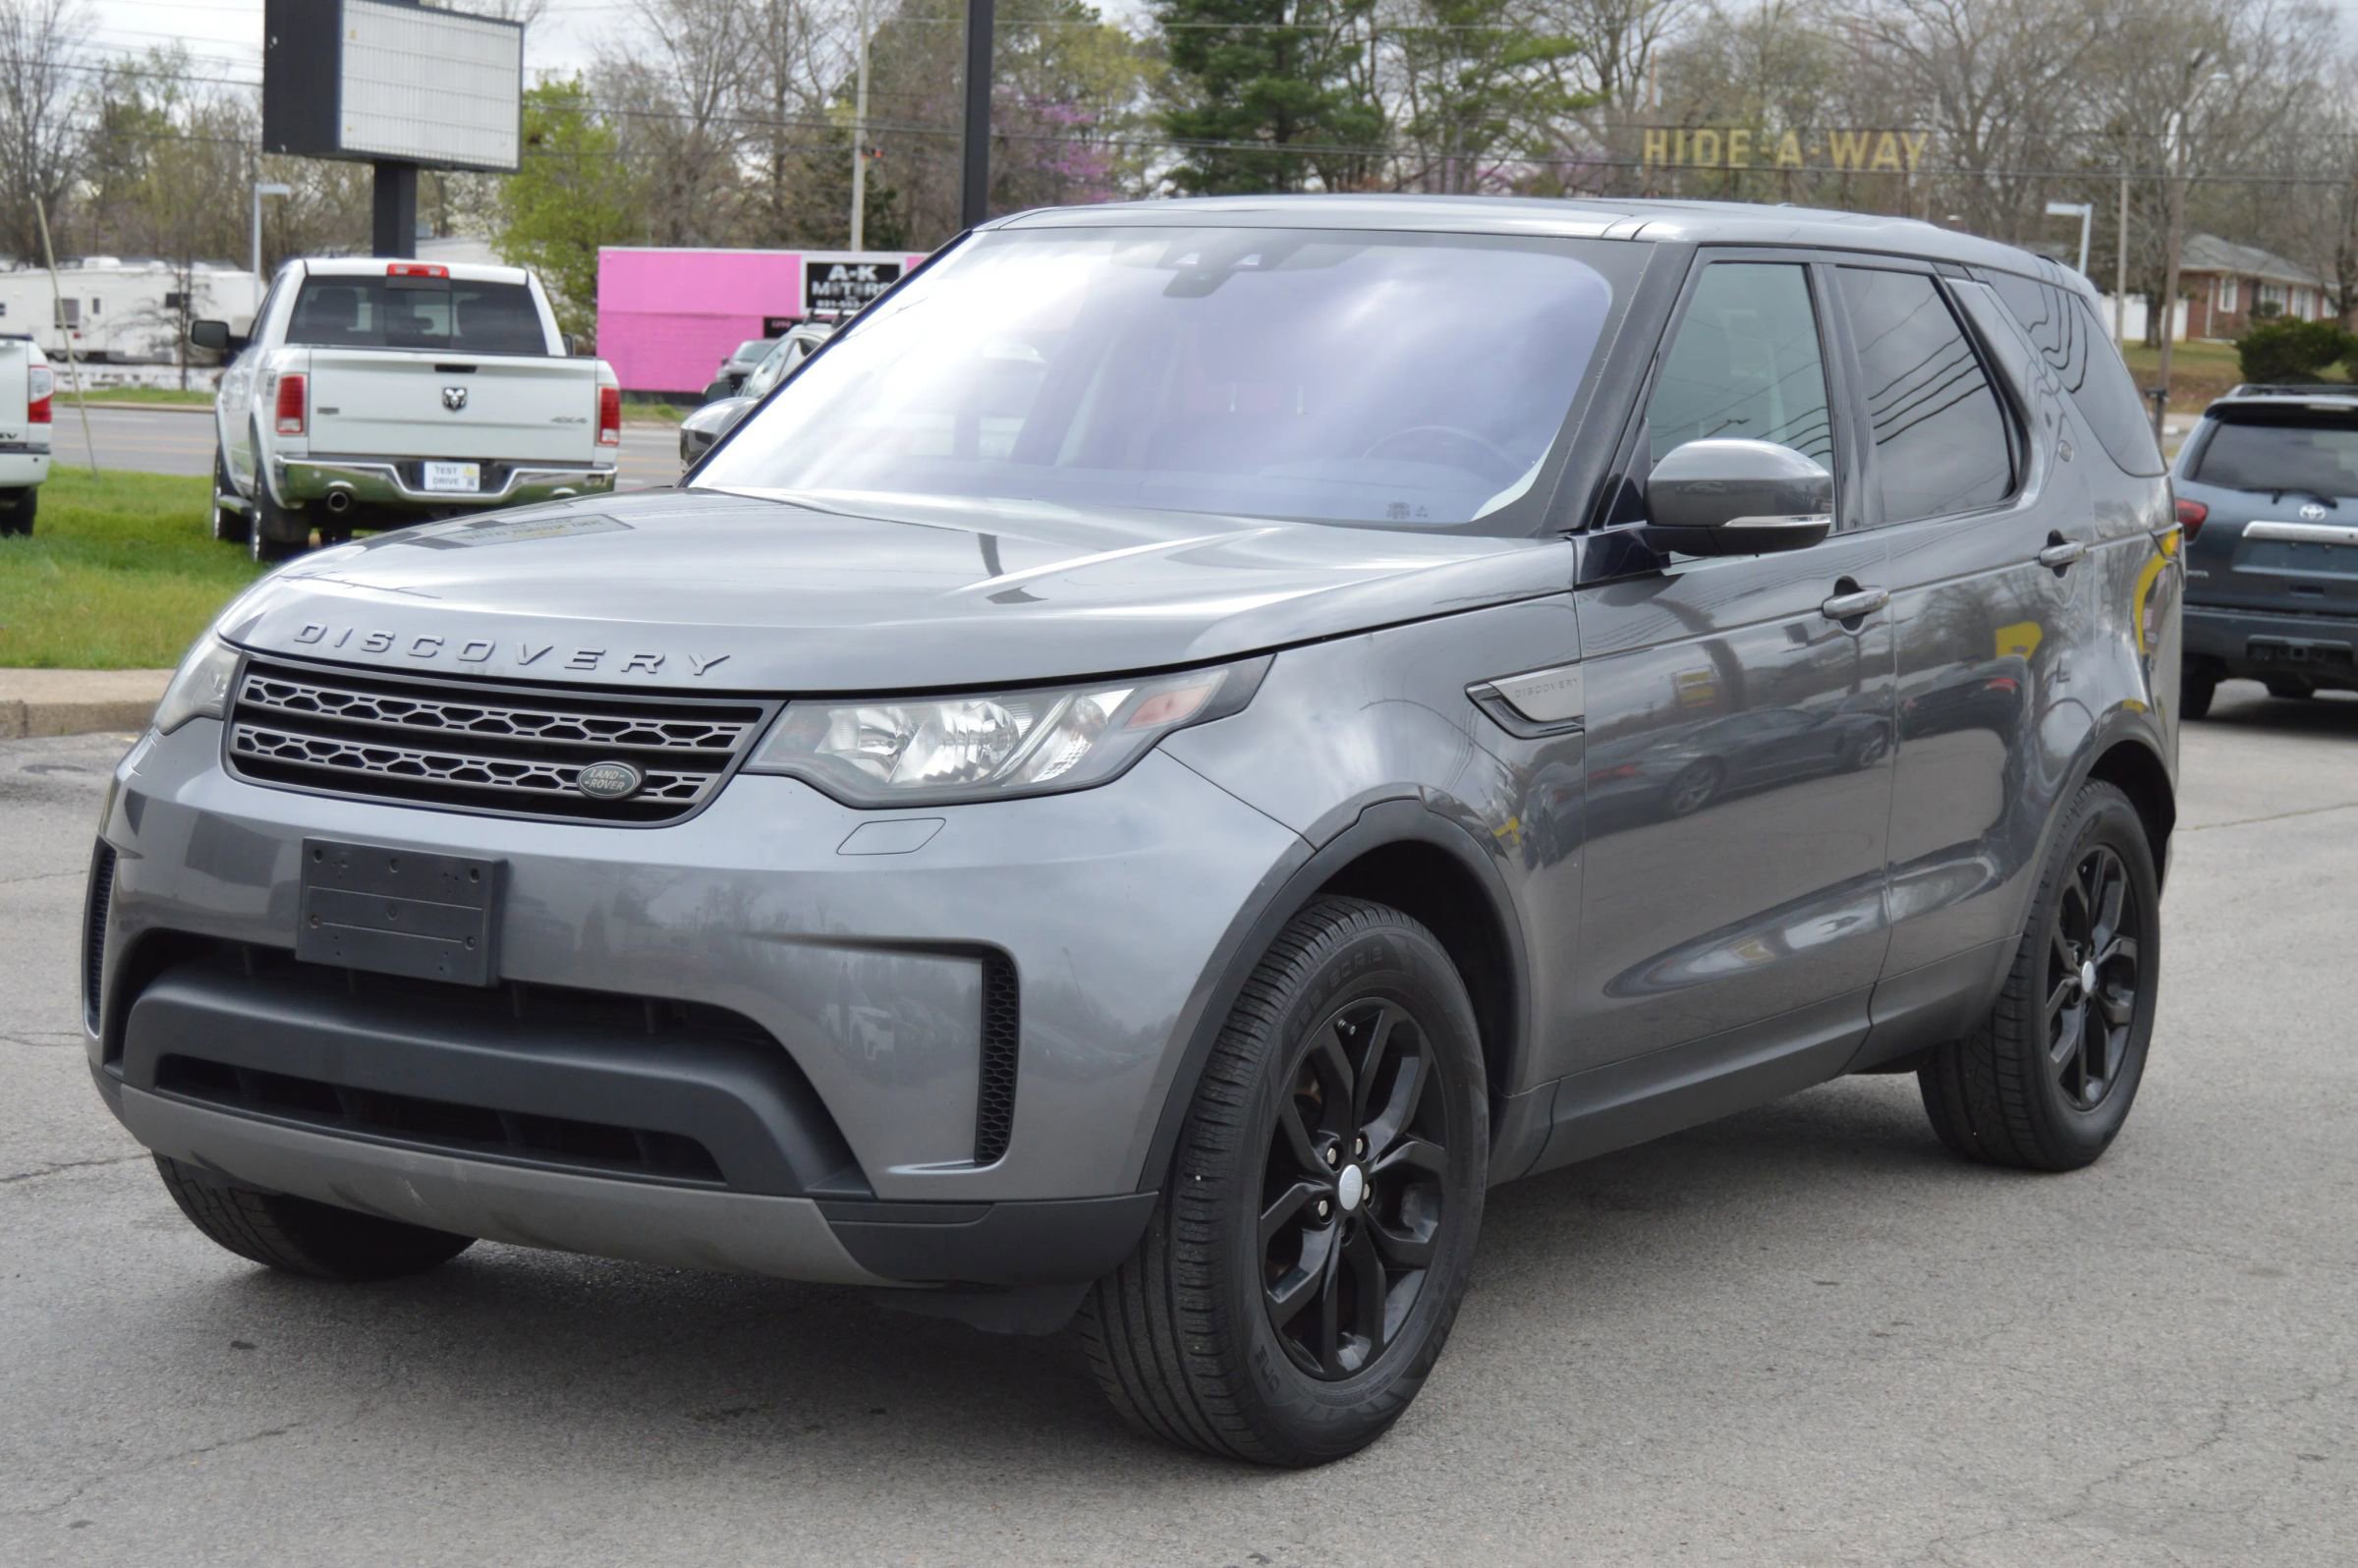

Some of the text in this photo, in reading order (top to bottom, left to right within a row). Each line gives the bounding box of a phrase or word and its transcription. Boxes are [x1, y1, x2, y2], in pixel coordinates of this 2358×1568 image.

[1643, 128, 1930, 172] HIDE-A-WAY
[827, 264, 878, 281] A-K
[434, 466, 457, 475] TEST
[294, 621, 731, 676] DISCOVERY
